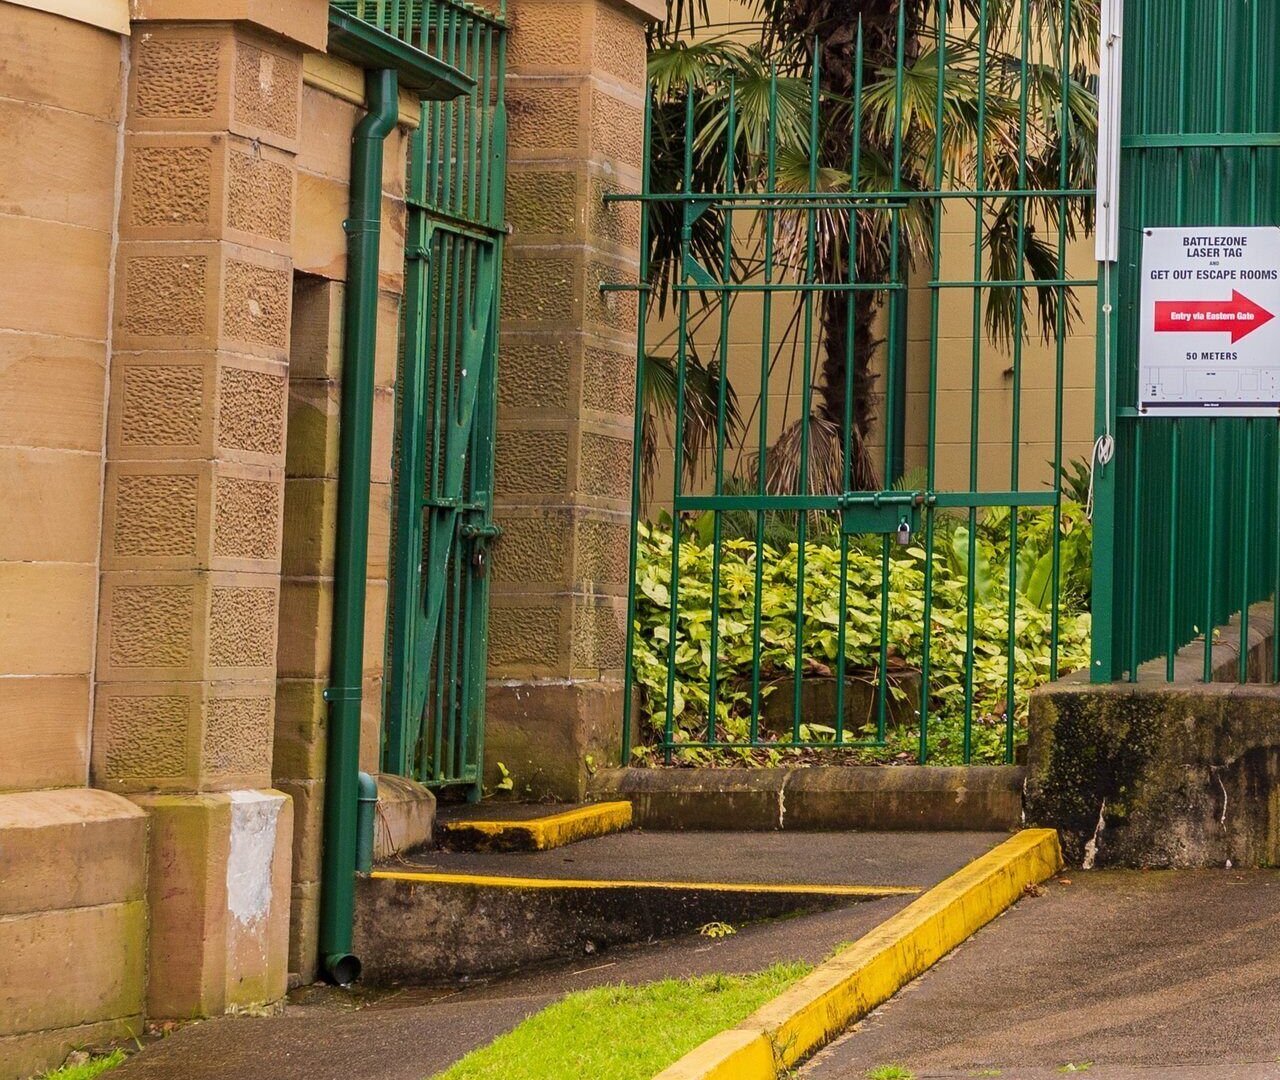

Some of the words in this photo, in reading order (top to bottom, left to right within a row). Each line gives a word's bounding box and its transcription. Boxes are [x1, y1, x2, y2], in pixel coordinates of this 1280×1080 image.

[1183, 236, 1247, 246] BATTLEZONE
[1187, 247, 1220, 258] LASER
[1223, 247, 1242, 258] TAG
[1150, 270, 1170, 280] GET
[1173, 270, 1192, 280] OUT
[1196, 270, 1236, 280] ESCAPE
[1239, 270, 1278, 280] ROOMS
[1171, 312, 1191, 321] Entry
[1193, 312, 1204, 320] via
[1206, 312, 1235, 320] Eastern
[1237, 311, 1254, 320] Gate
[1186, 352, 1197, 360] 50
[1201, 352, 1238, 360] METERS
